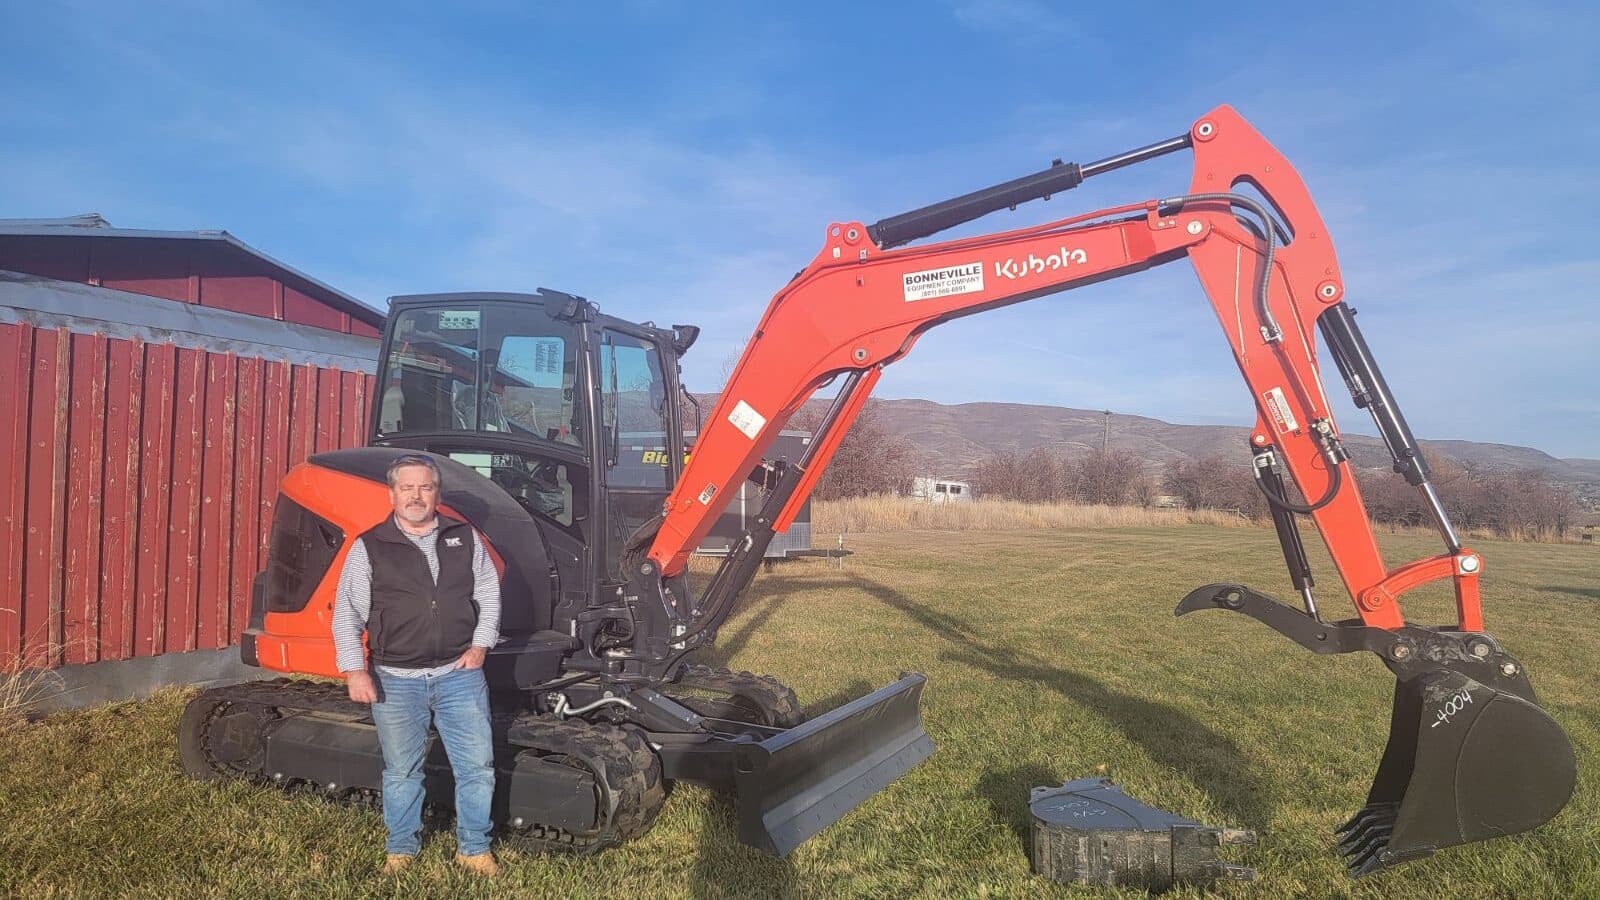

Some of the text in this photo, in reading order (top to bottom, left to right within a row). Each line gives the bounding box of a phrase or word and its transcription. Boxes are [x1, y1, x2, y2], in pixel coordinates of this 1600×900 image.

[994, 246, 1087, 280] Kubota
[905, 266, 980, 285] BONNEVILLE
[907, 276, 979, 292] EQUIPMENT COMPANY
